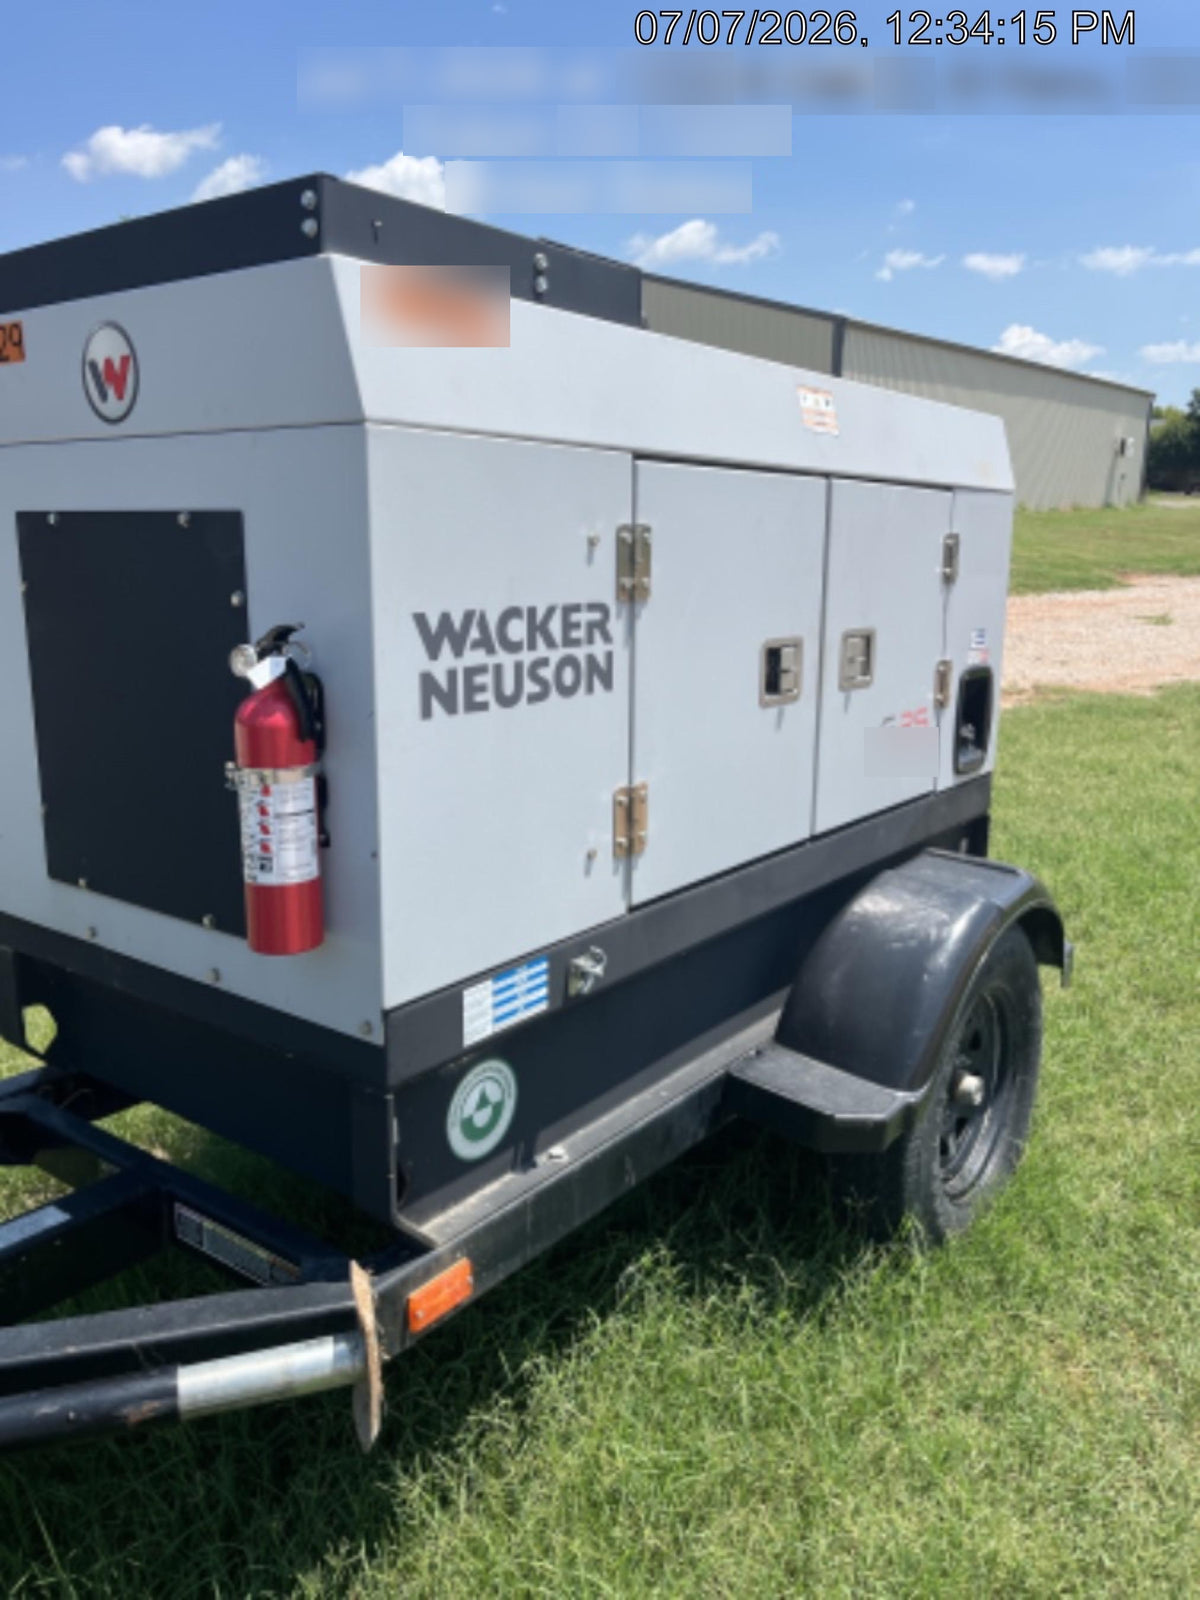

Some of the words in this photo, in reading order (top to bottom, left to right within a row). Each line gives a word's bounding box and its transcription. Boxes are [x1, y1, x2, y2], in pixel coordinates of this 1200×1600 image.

[88, 354, 131, 403] W
[412, 602, 613, 661] WACKER
[418, 650, 614, 721] NEUSON
